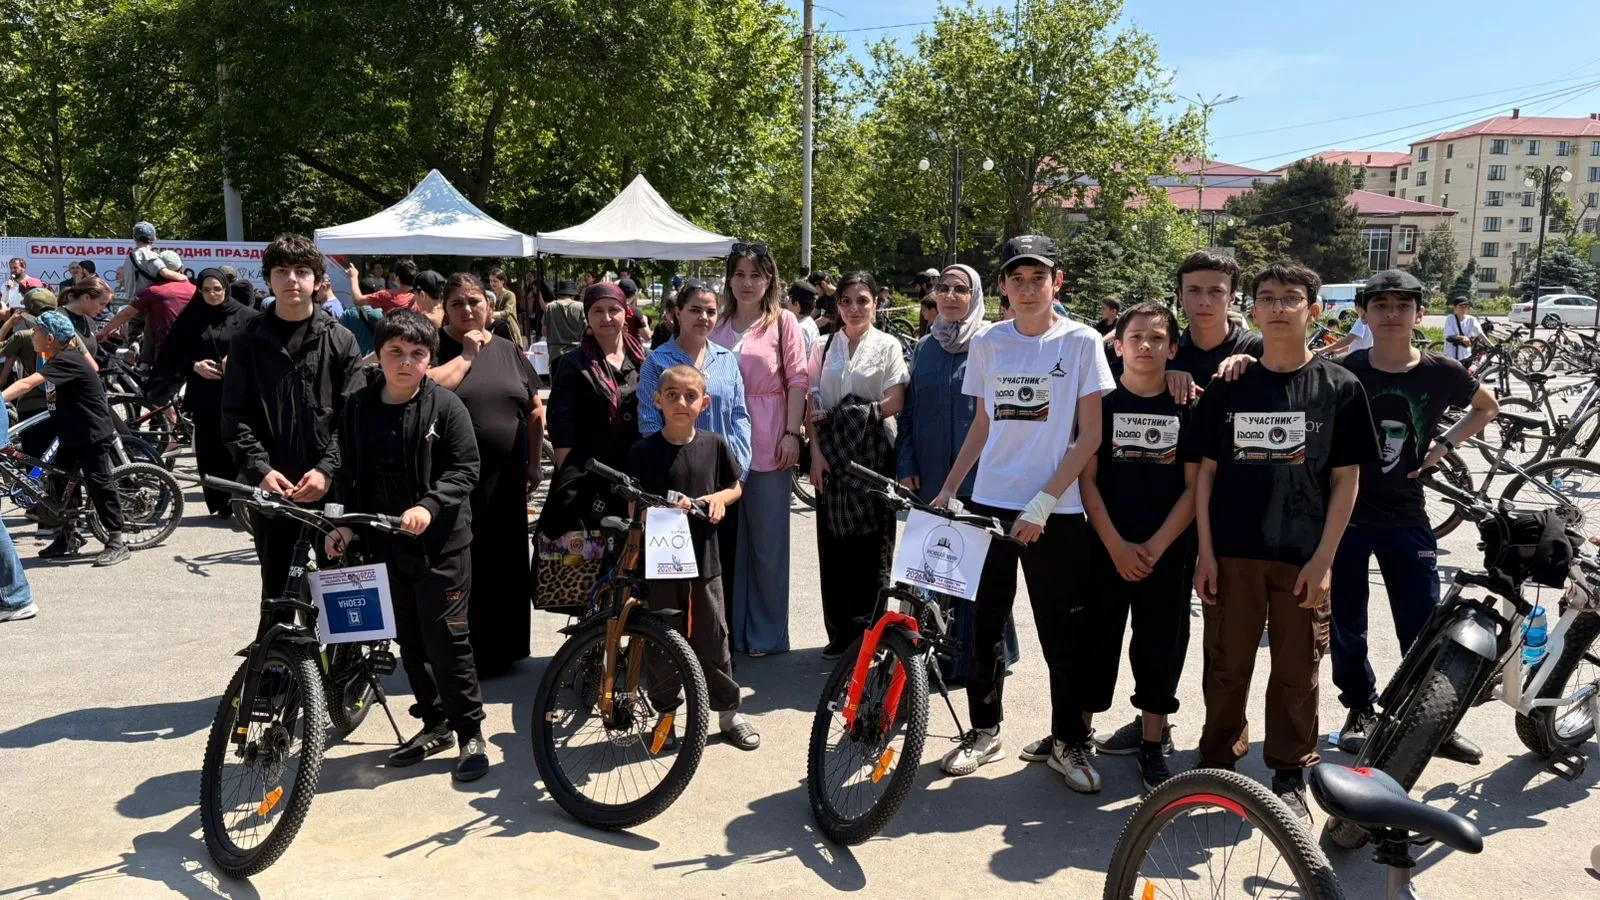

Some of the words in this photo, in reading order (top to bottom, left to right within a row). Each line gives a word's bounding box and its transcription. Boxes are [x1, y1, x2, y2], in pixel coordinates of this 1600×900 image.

[31, 245, 113, 256] БЛАГОДАРЯ
[117, 246, 133, 256] ВА
[1002, 376, 1041, 384] УЧАСТНИК
[1127, 417, 1168, 427] УЧАСТНИК
[1248, 416, 1292, 425] УЧАСТНИК
[338, 597, 366, 608] СЕЗОНА
